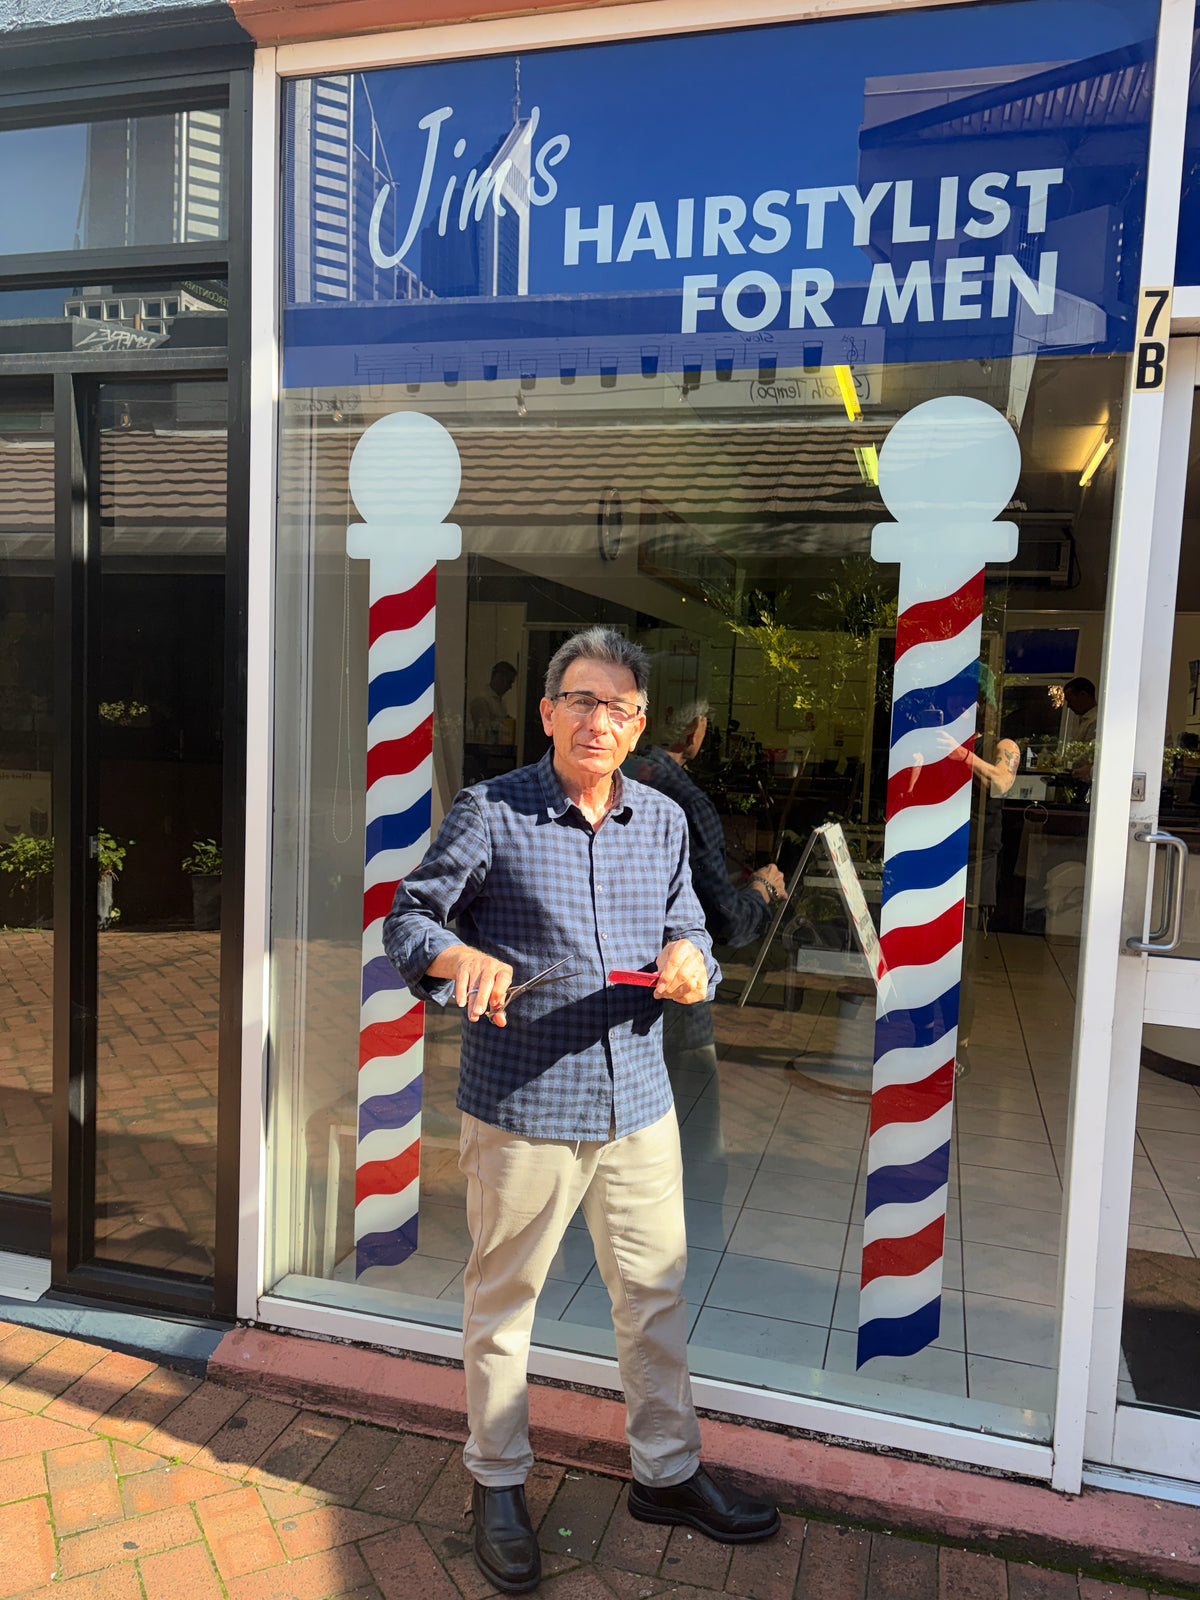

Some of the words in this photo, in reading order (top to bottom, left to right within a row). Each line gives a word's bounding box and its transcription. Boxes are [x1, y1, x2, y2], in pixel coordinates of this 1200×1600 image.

[369, 106, 570, 269] Jim's
[563, 167, 1064, 266] HAIRSTYLIST
[680, 267, 835, 334] FOR
[861, 251, 1059, 326] MEN
